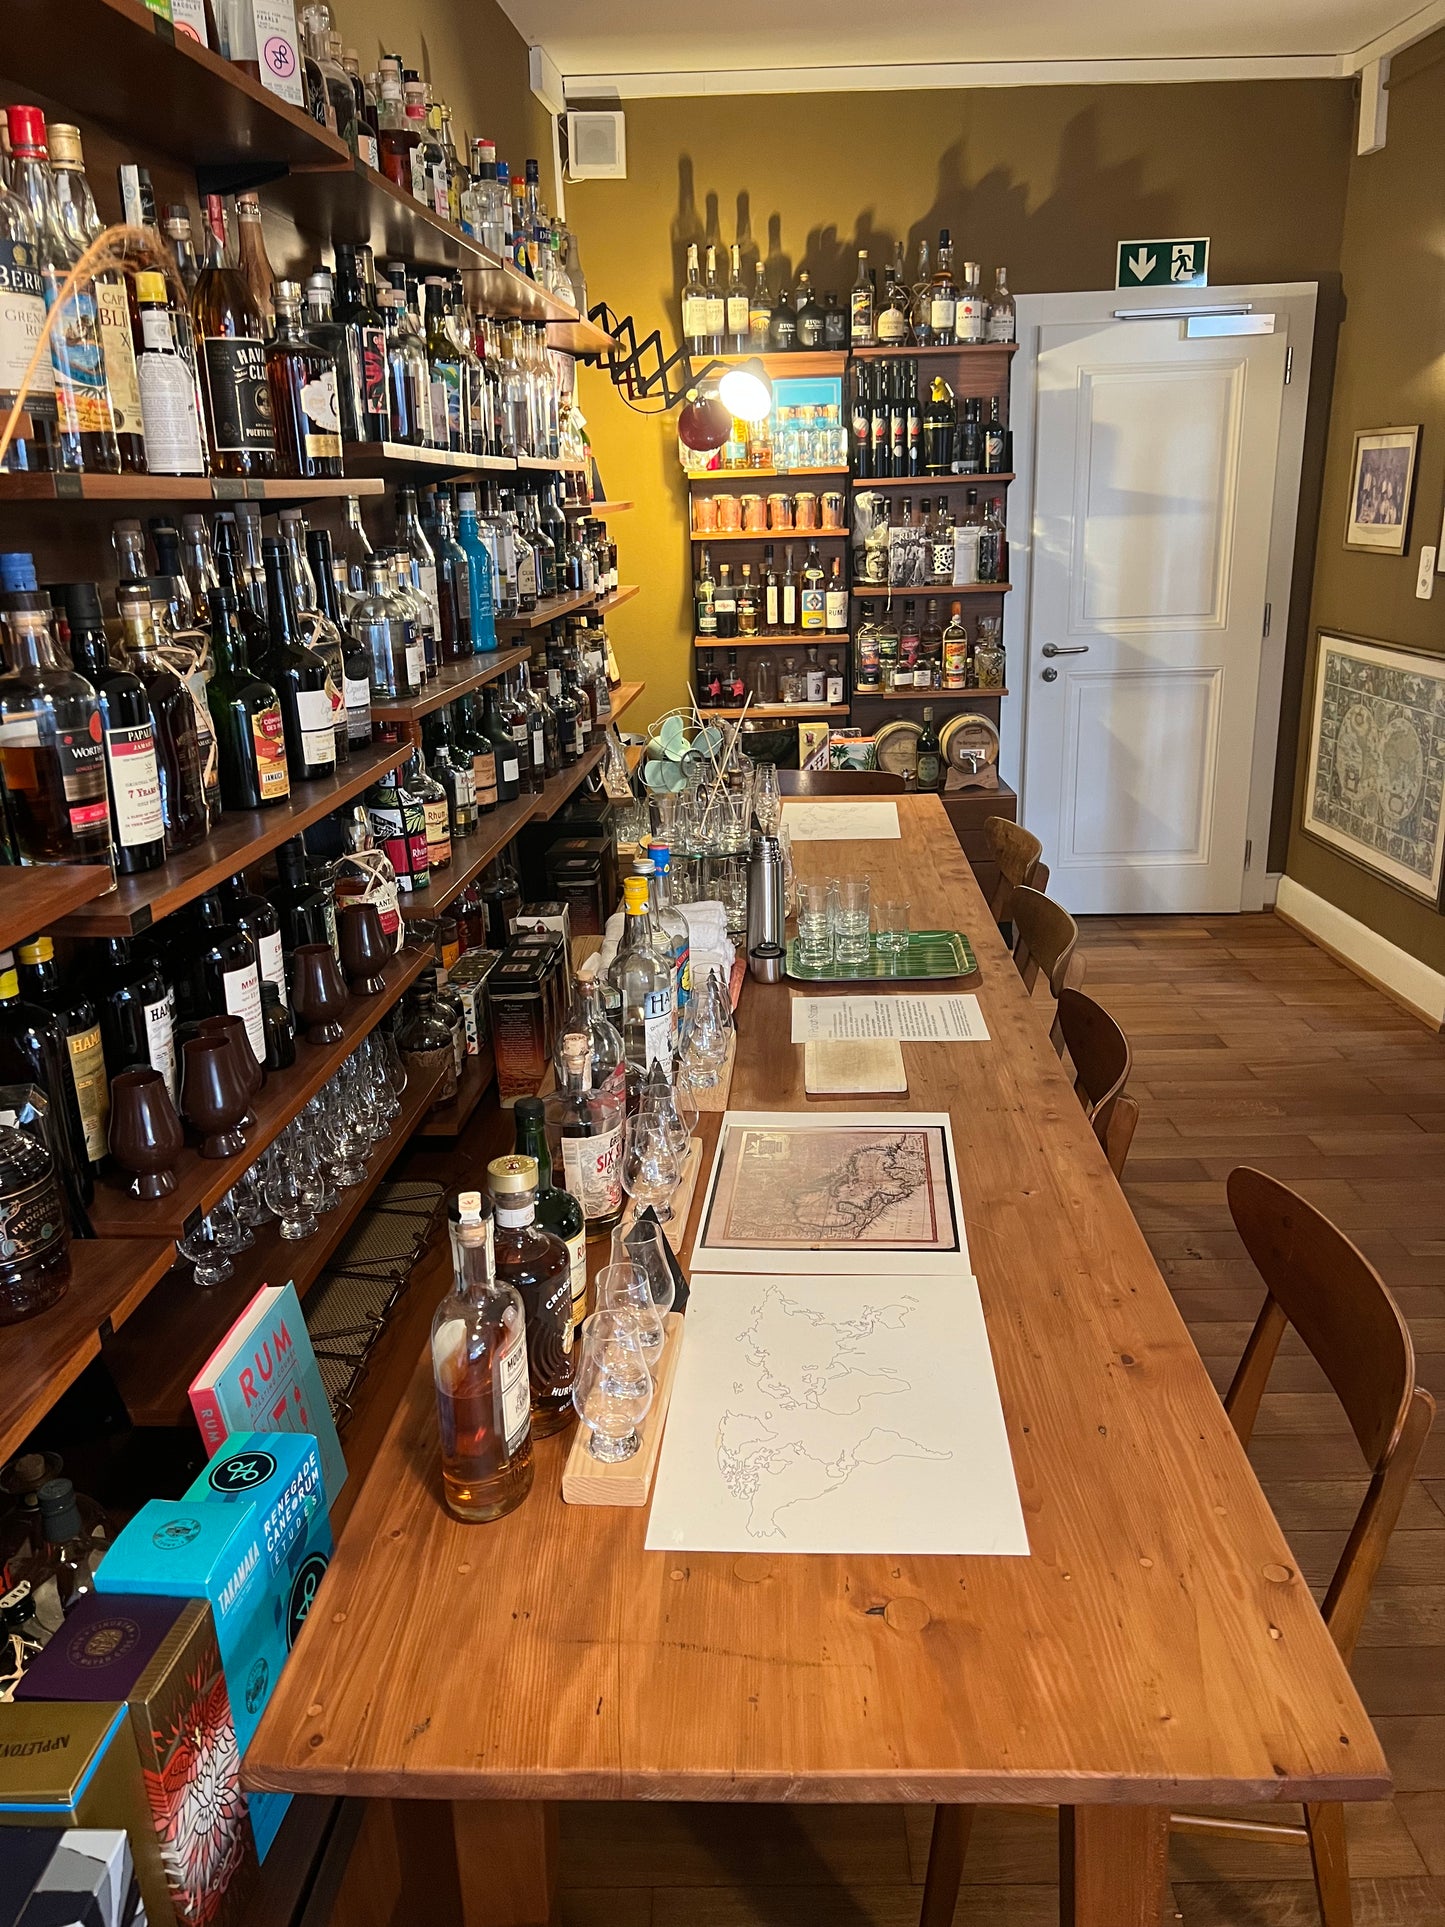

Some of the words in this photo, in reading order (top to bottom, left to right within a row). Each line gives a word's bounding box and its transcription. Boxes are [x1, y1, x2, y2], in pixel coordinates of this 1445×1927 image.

[127, 789, 134, 799] 7
[596, 1146, 614, 1173] SIX
[238, 1317, 293, 1409] RUM
[200, 1408, 220, 1443] RUM
[263, 1450, 316, 1537] RENEGADE
[266, 1505, 292, 1553] CANE
[298, 1466, 320, 1499] RUM
[217, 1540, 261, 1615] TAKAMAKA
